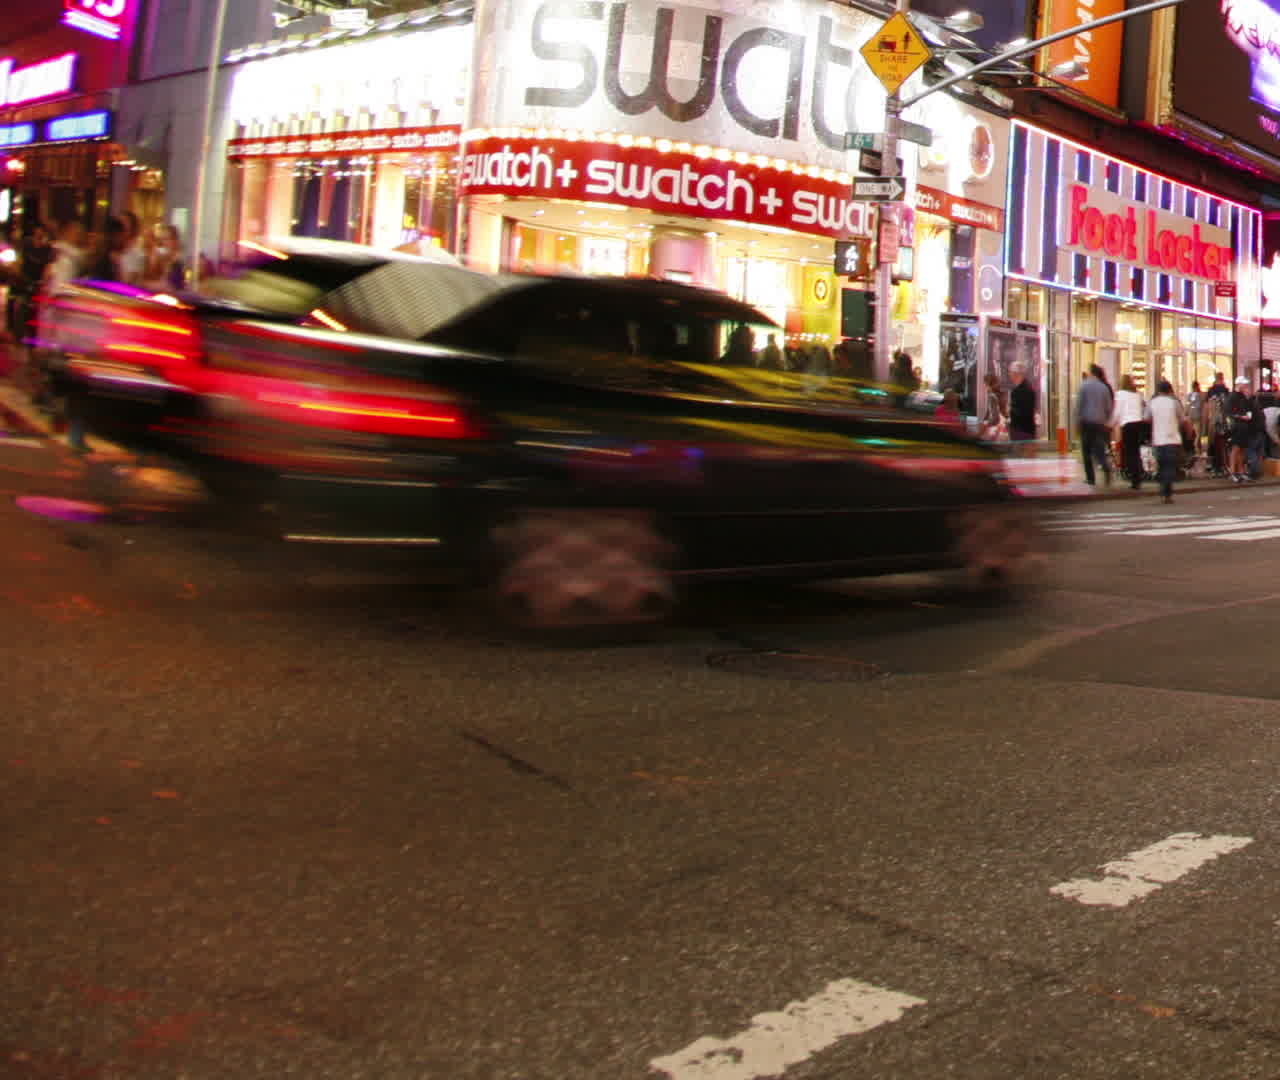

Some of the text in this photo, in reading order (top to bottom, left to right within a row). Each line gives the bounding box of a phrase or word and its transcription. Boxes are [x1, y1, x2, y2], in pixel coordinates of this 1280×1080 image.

[462, 145, 552, 187] swatch
[585, 156, 753, 214] swatch
[858, 183, 899, 196] ONE WAY
[1068, 184, 1233, 280] Foot Locker
